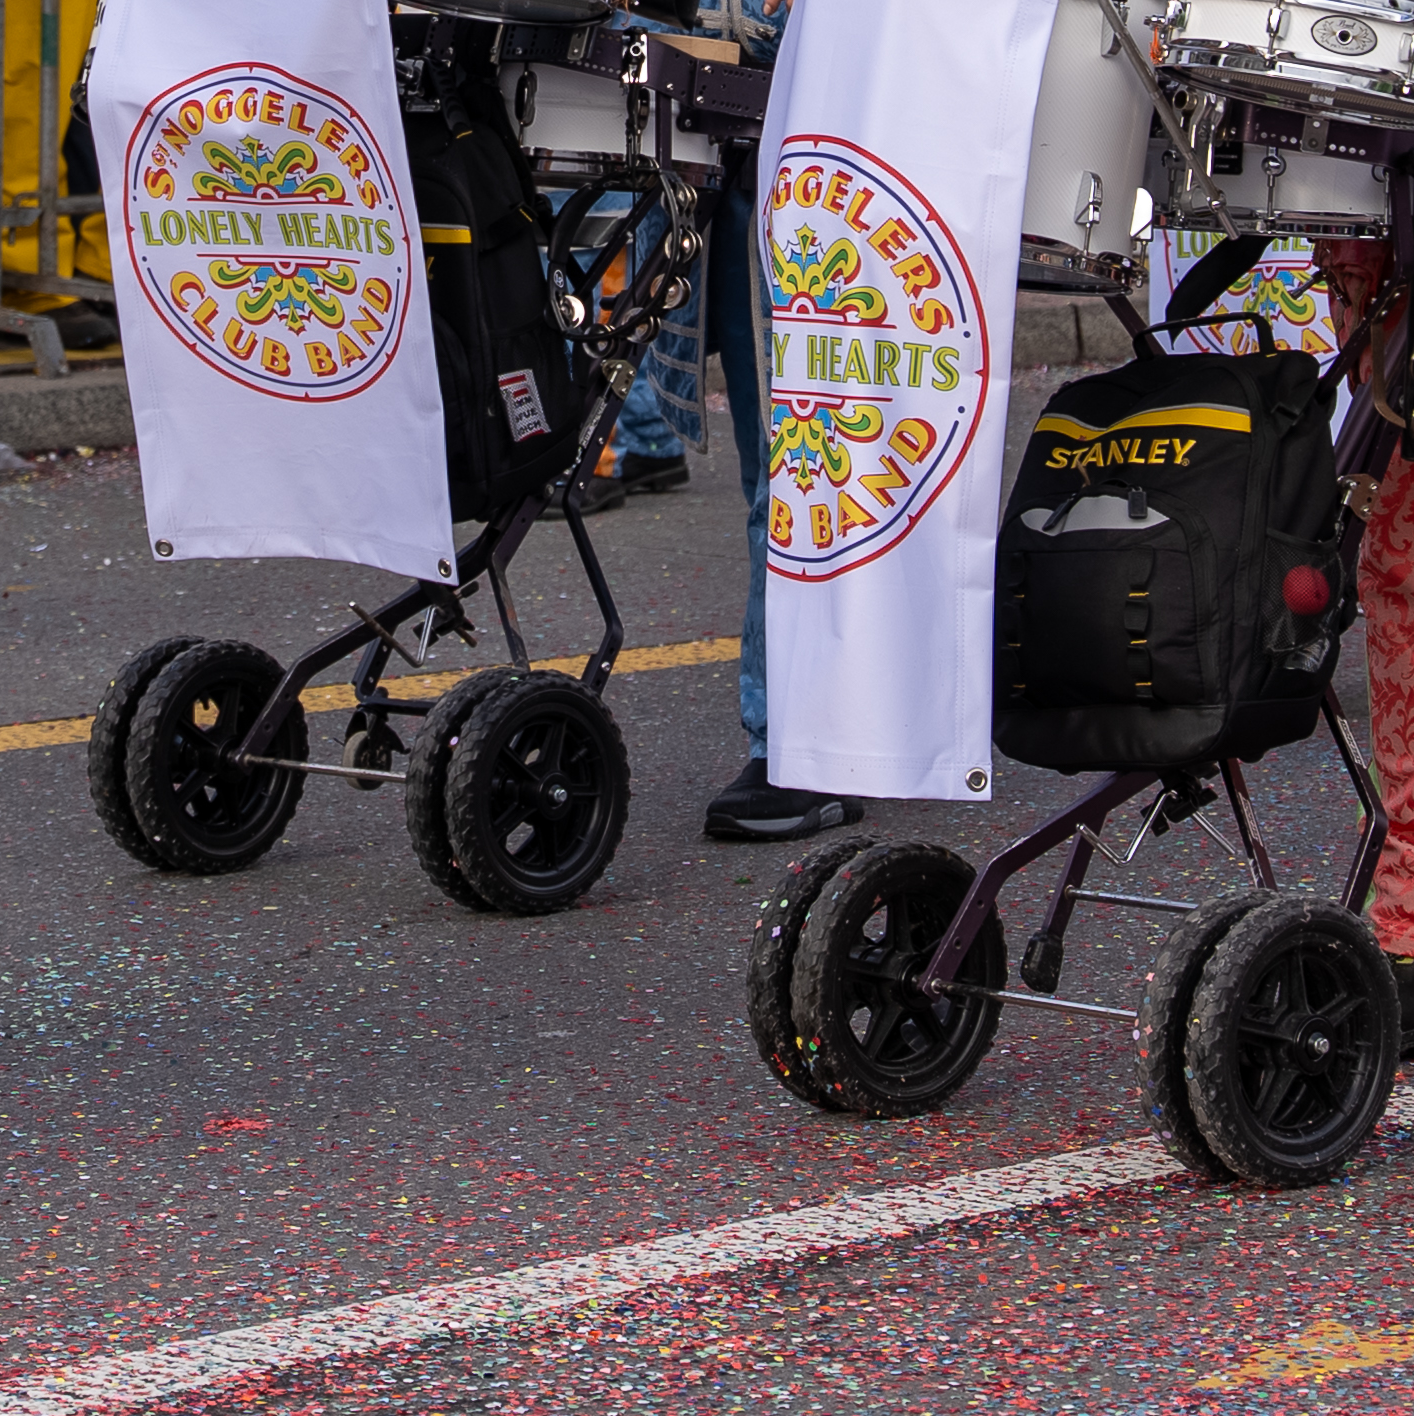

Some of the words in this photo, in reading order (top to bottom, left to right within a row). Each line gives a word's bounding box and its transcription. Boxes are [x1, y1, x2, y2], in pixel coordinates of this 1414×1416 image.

[167, 87, 380, 210] NOGGELERS
[139, 209, 266, 248] LONELY
[278, 213, 396, 258] HEARTS
[170, 271, 290, 377] CLUB
[303, 277, 393, 378] BAND
[807, 336, 960, 392] HEARTS
[810, 418, 937, 550] BAND
[1045, 439, 1196, 469] STANLEY
